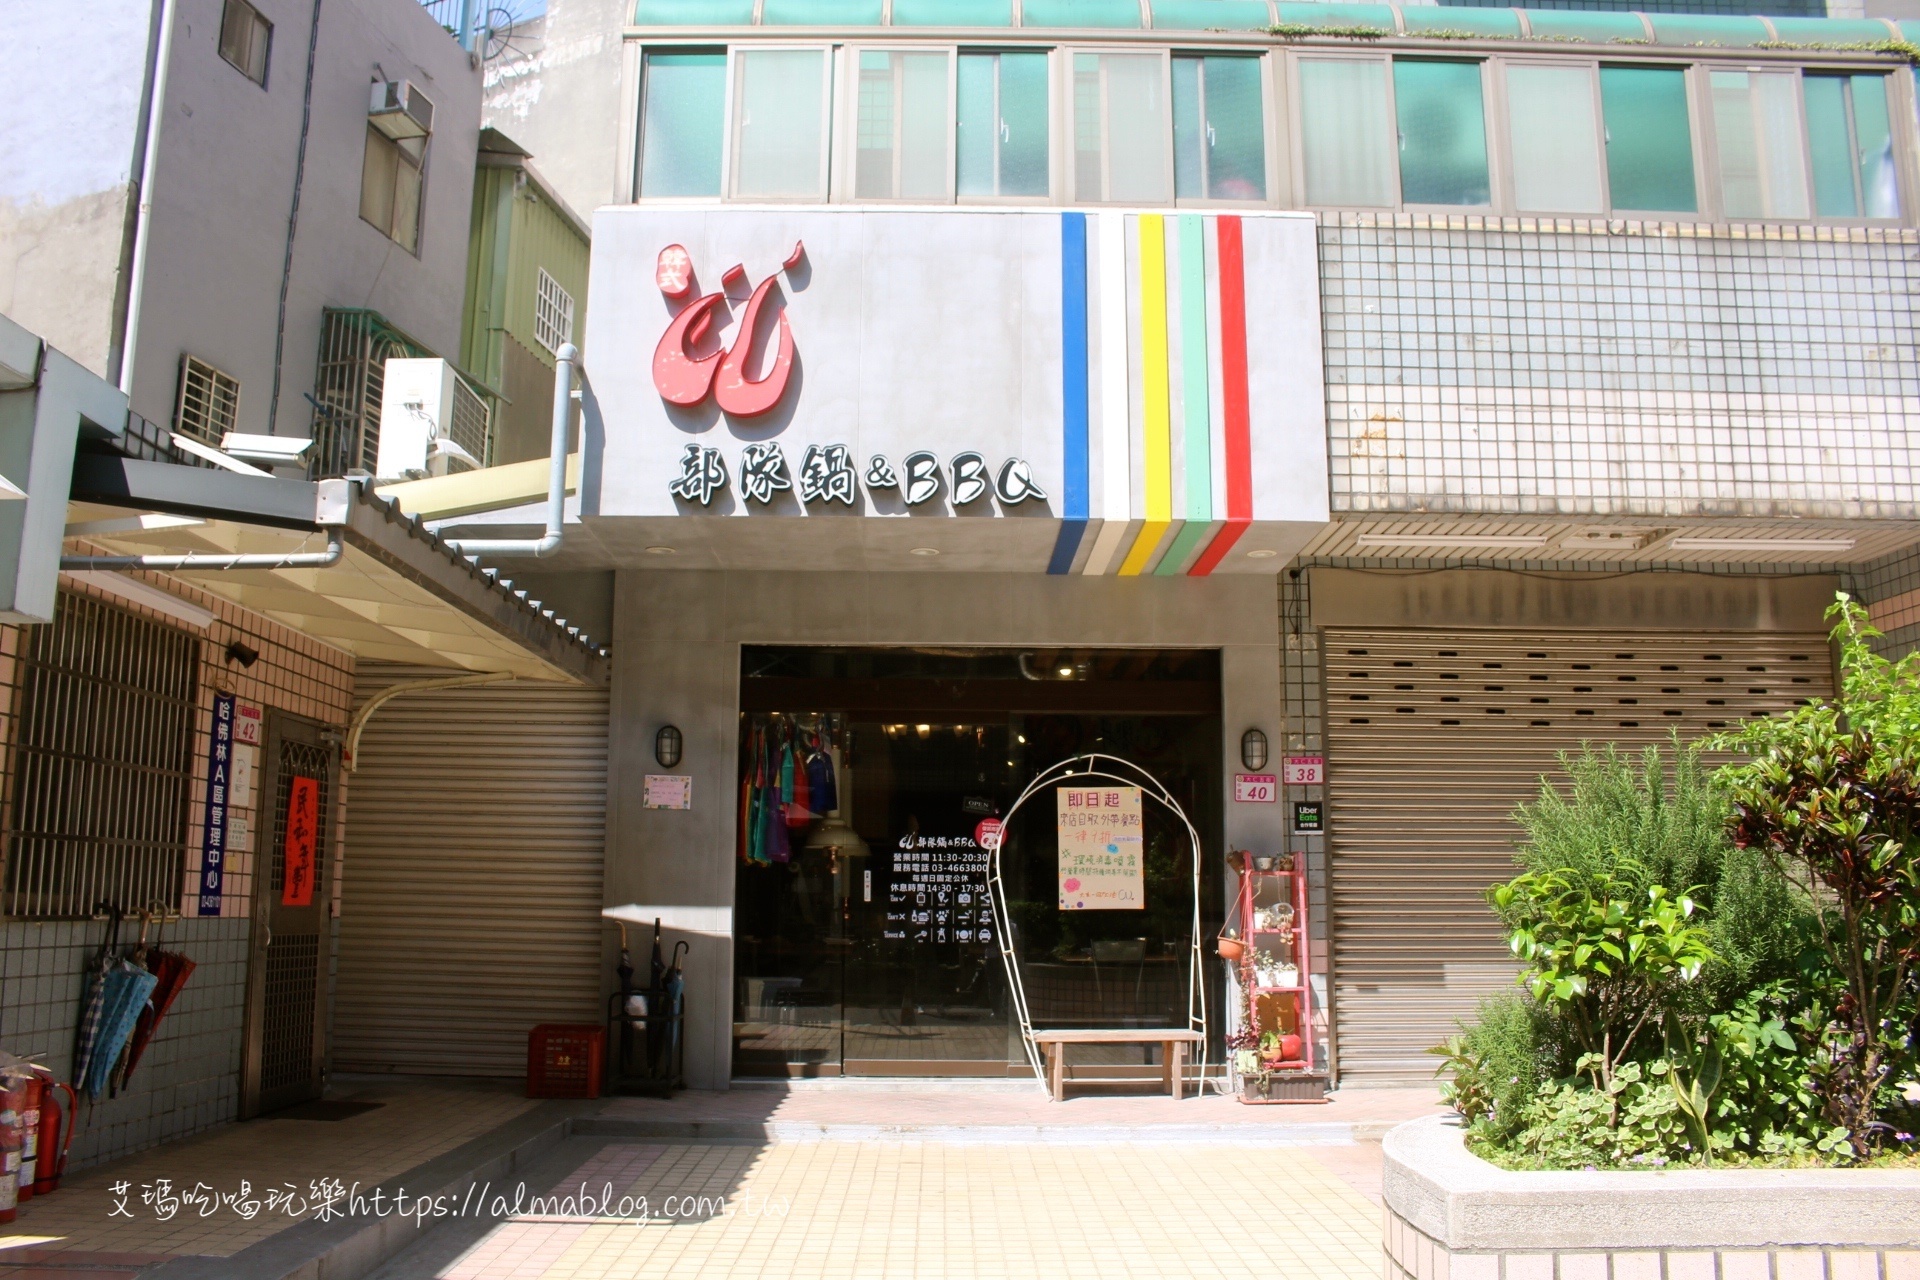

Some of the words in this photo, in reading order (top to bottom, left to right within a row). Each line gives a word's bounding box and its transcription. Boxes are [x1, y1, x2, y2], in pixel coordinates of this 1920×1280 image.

[242, 723, 255, 740] 42
[1296, 769, 1316, 781] 38
[206, 701, 231, 890] 哈佛林A區管理中心
[1247, 787, 1268, 800] 40
[1067, 792, 1120, 808] 即日起
[893, 853, 930, 862] 營業時間
[932, 853, 988, 862] 11:30-20:30
[893, 863, 930, 872] 服務電話
[931, 864, 988, 872] 03-4663800
[912, 874, 969, 882] 每週日固定公休
[890, 883, 926, 892] 休息時間
[927, 884, 952, 892] 14:30
[961, 884, 985, 892] 17:30
